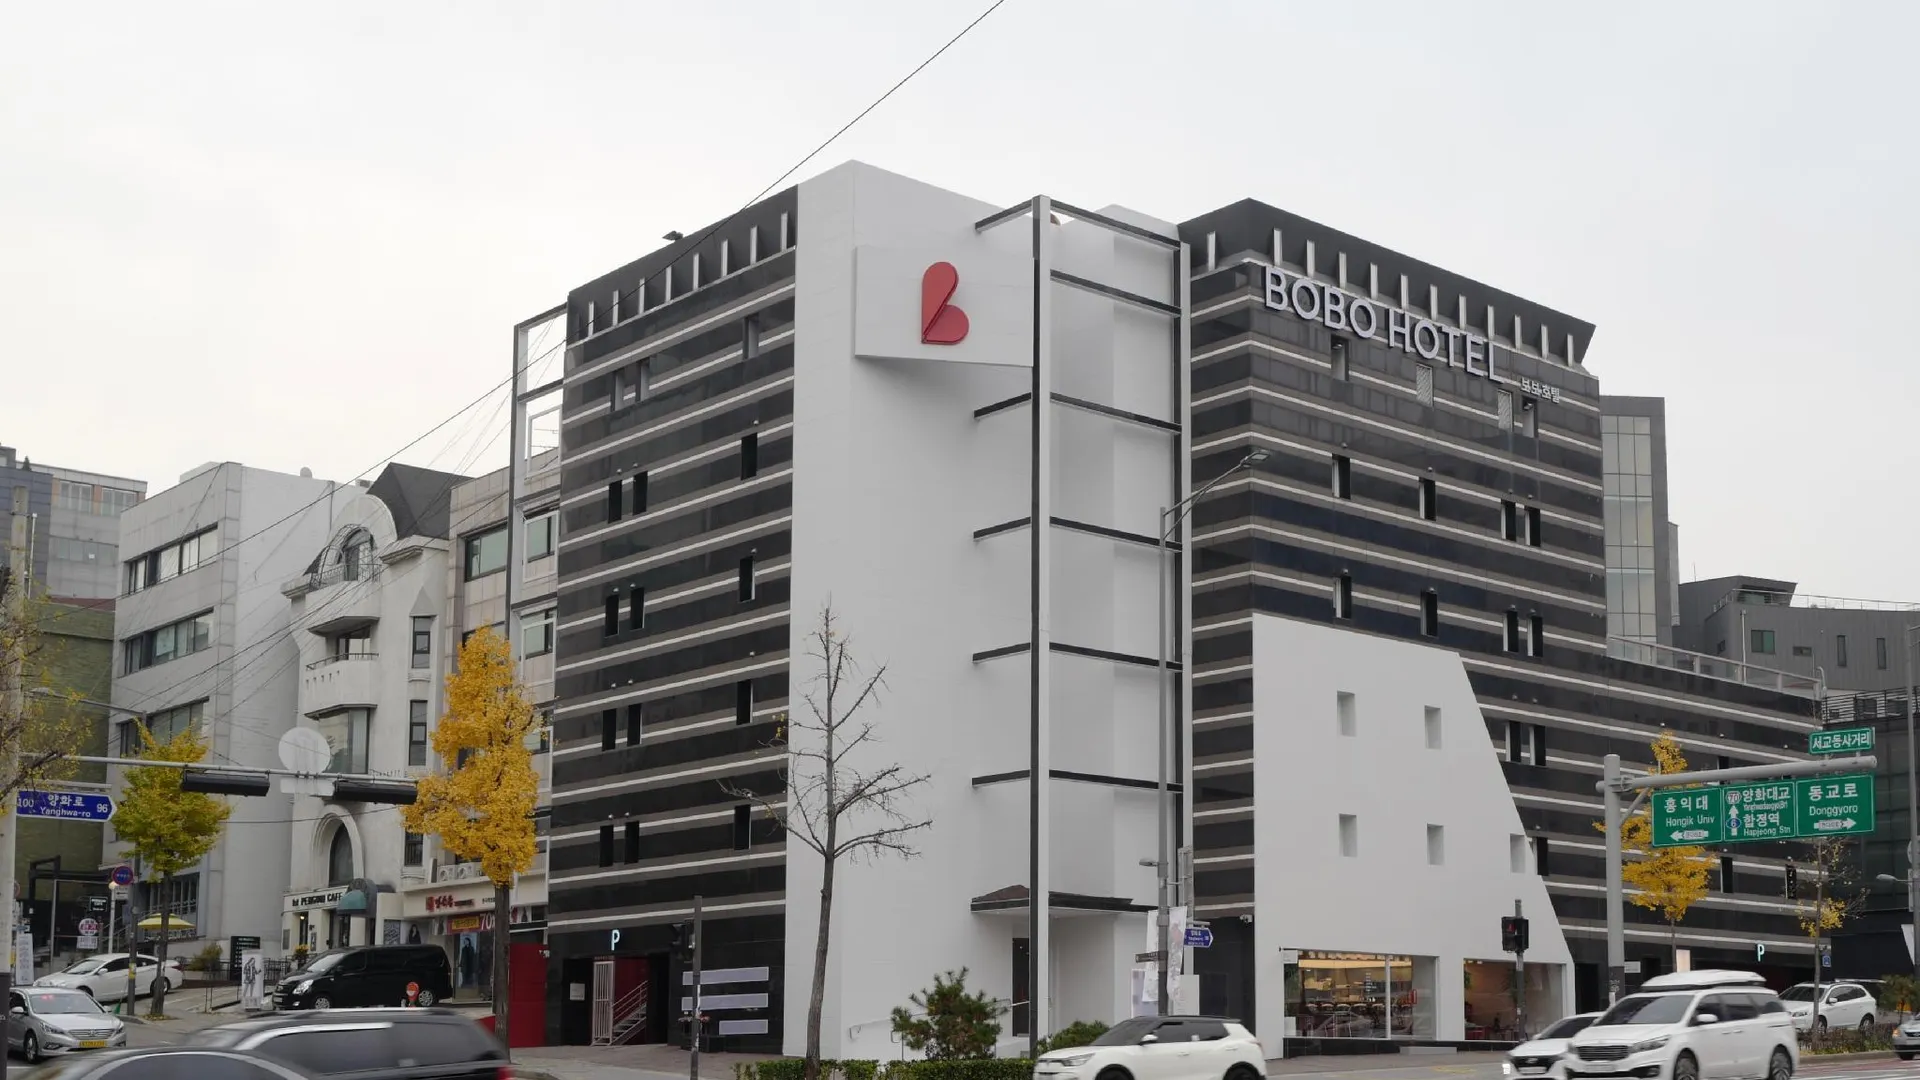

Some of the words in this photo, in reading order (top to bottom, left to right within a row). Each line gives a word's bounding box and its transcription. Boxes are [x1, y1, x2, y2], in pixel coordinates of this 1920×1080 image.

[1265, 265, 1376, 338] BOBO
[1388, 308, 1505, 384] HOTEL
[1521, 376, 1560, 404] 보보호텔
[1812, 731, 1870, 750] 서교동사거리
[47, 794, 85, 807] 양화로
[1742, 786, 1791, 803] 양화대교
[1808, 783, 1859, 802] 동교로
[18, 798, 34, 808] 100
[96, 803, 108, 813] 96
[1664, 795, 1708, 813] 홍익대
[40, 806, 91, 818] Yanghwa-ro
[1743, 812, 1780, 828] 합정역
[1665, 816, 1694, 828] Hongik
[1697, 815, 1715, 825] Univ
[1731, 819, 1737, 827] 6
[1744, 828, 1777, 838] Hapjeong
[612, 928, 621, 951] P
[1757, 943, 1765, 962] P
